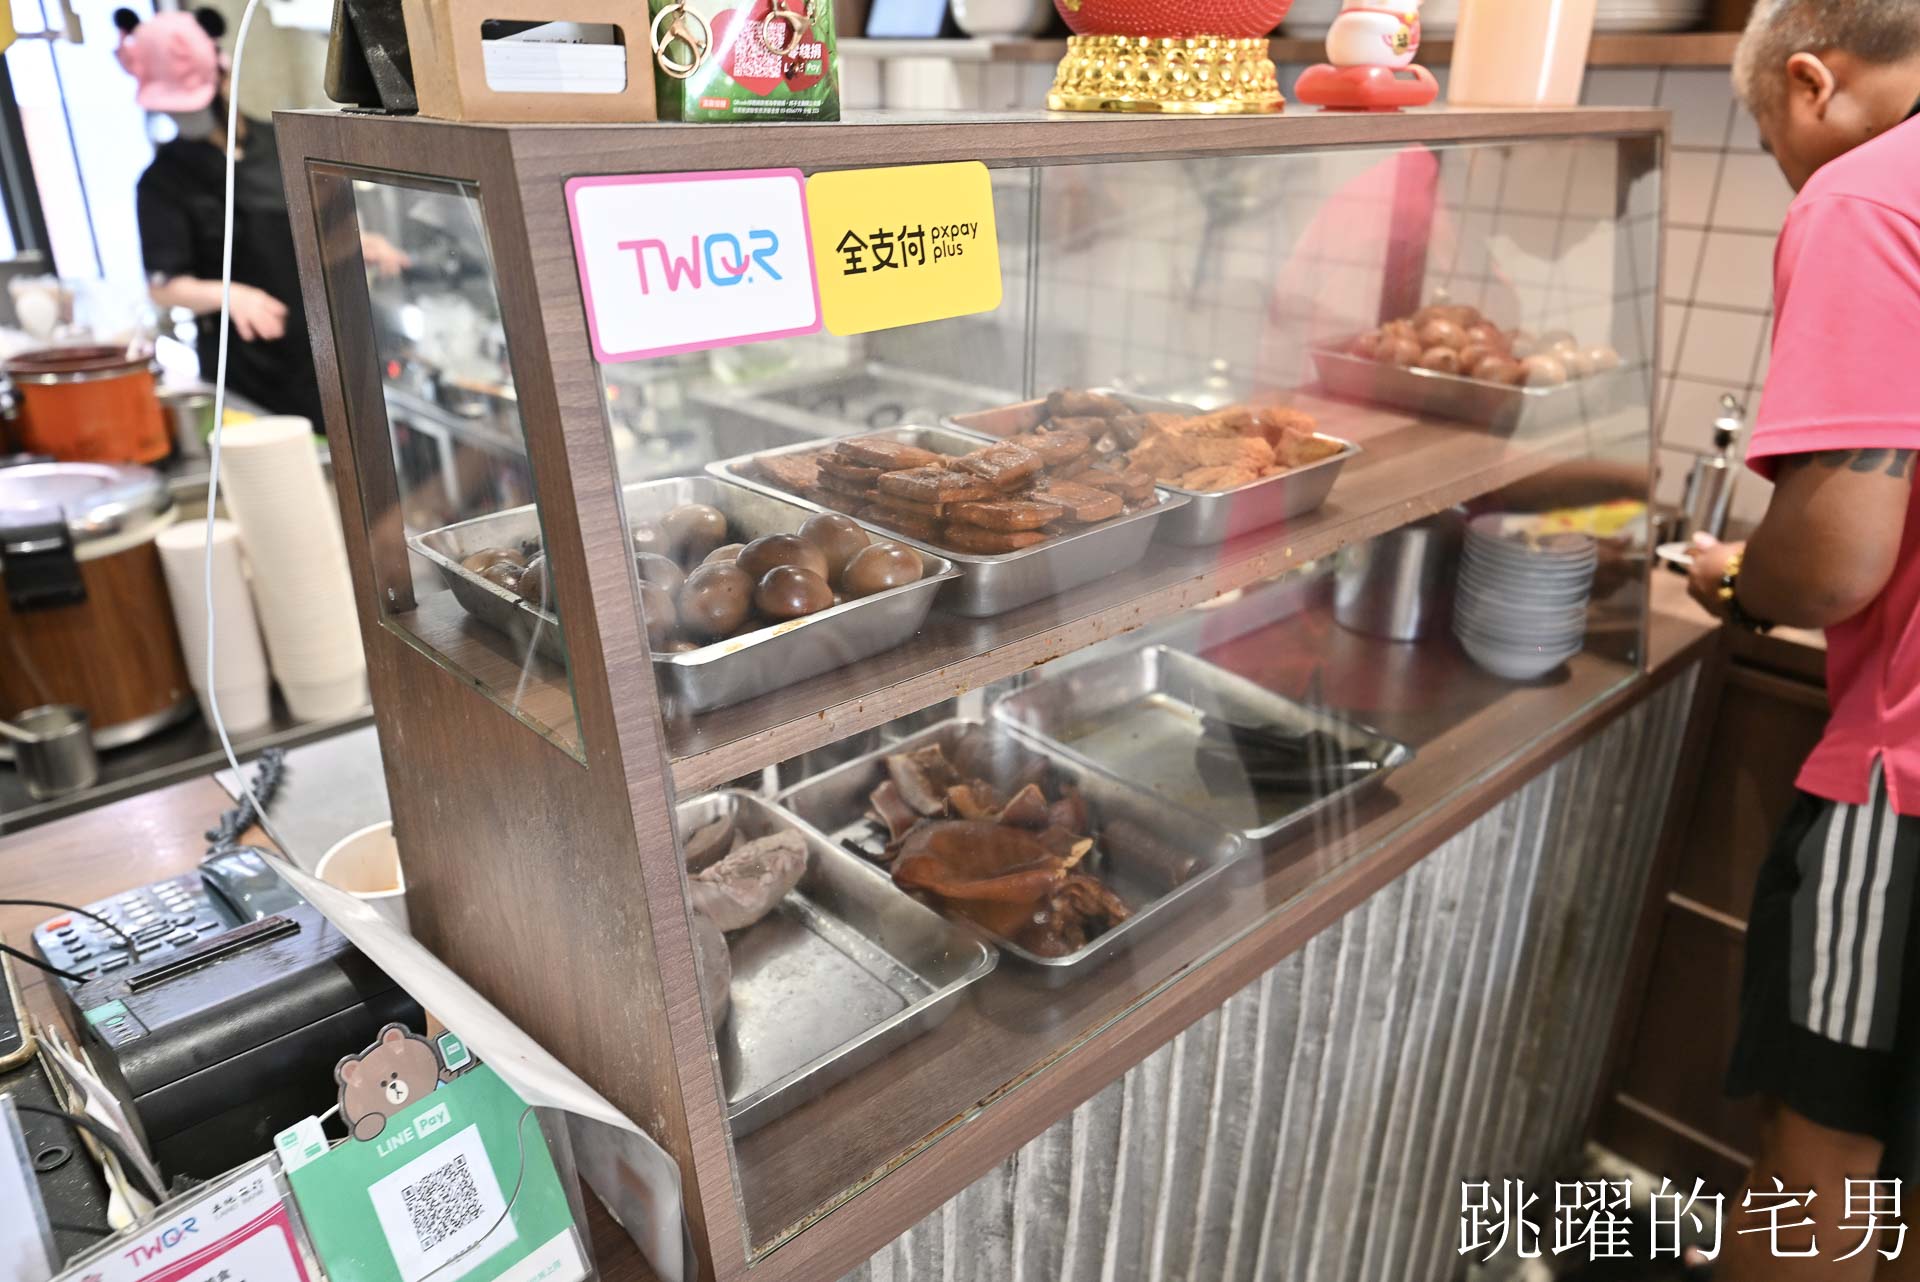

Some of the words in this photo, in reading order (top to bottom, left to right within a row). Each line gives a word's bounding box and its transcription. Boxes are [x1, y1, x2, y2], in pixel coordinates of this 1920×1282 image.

[835, 224, 925, 276] 全支付
[931, 221, 978, 244] pxpay
[933, 240, 964, 264] plus
[617, 229, 783, 295] TWQR
[375, 1126, 415, 1159] LINE
[417, 1110, 446, 1131] Pay
[123, 1216, 200, 1268] TWQR
